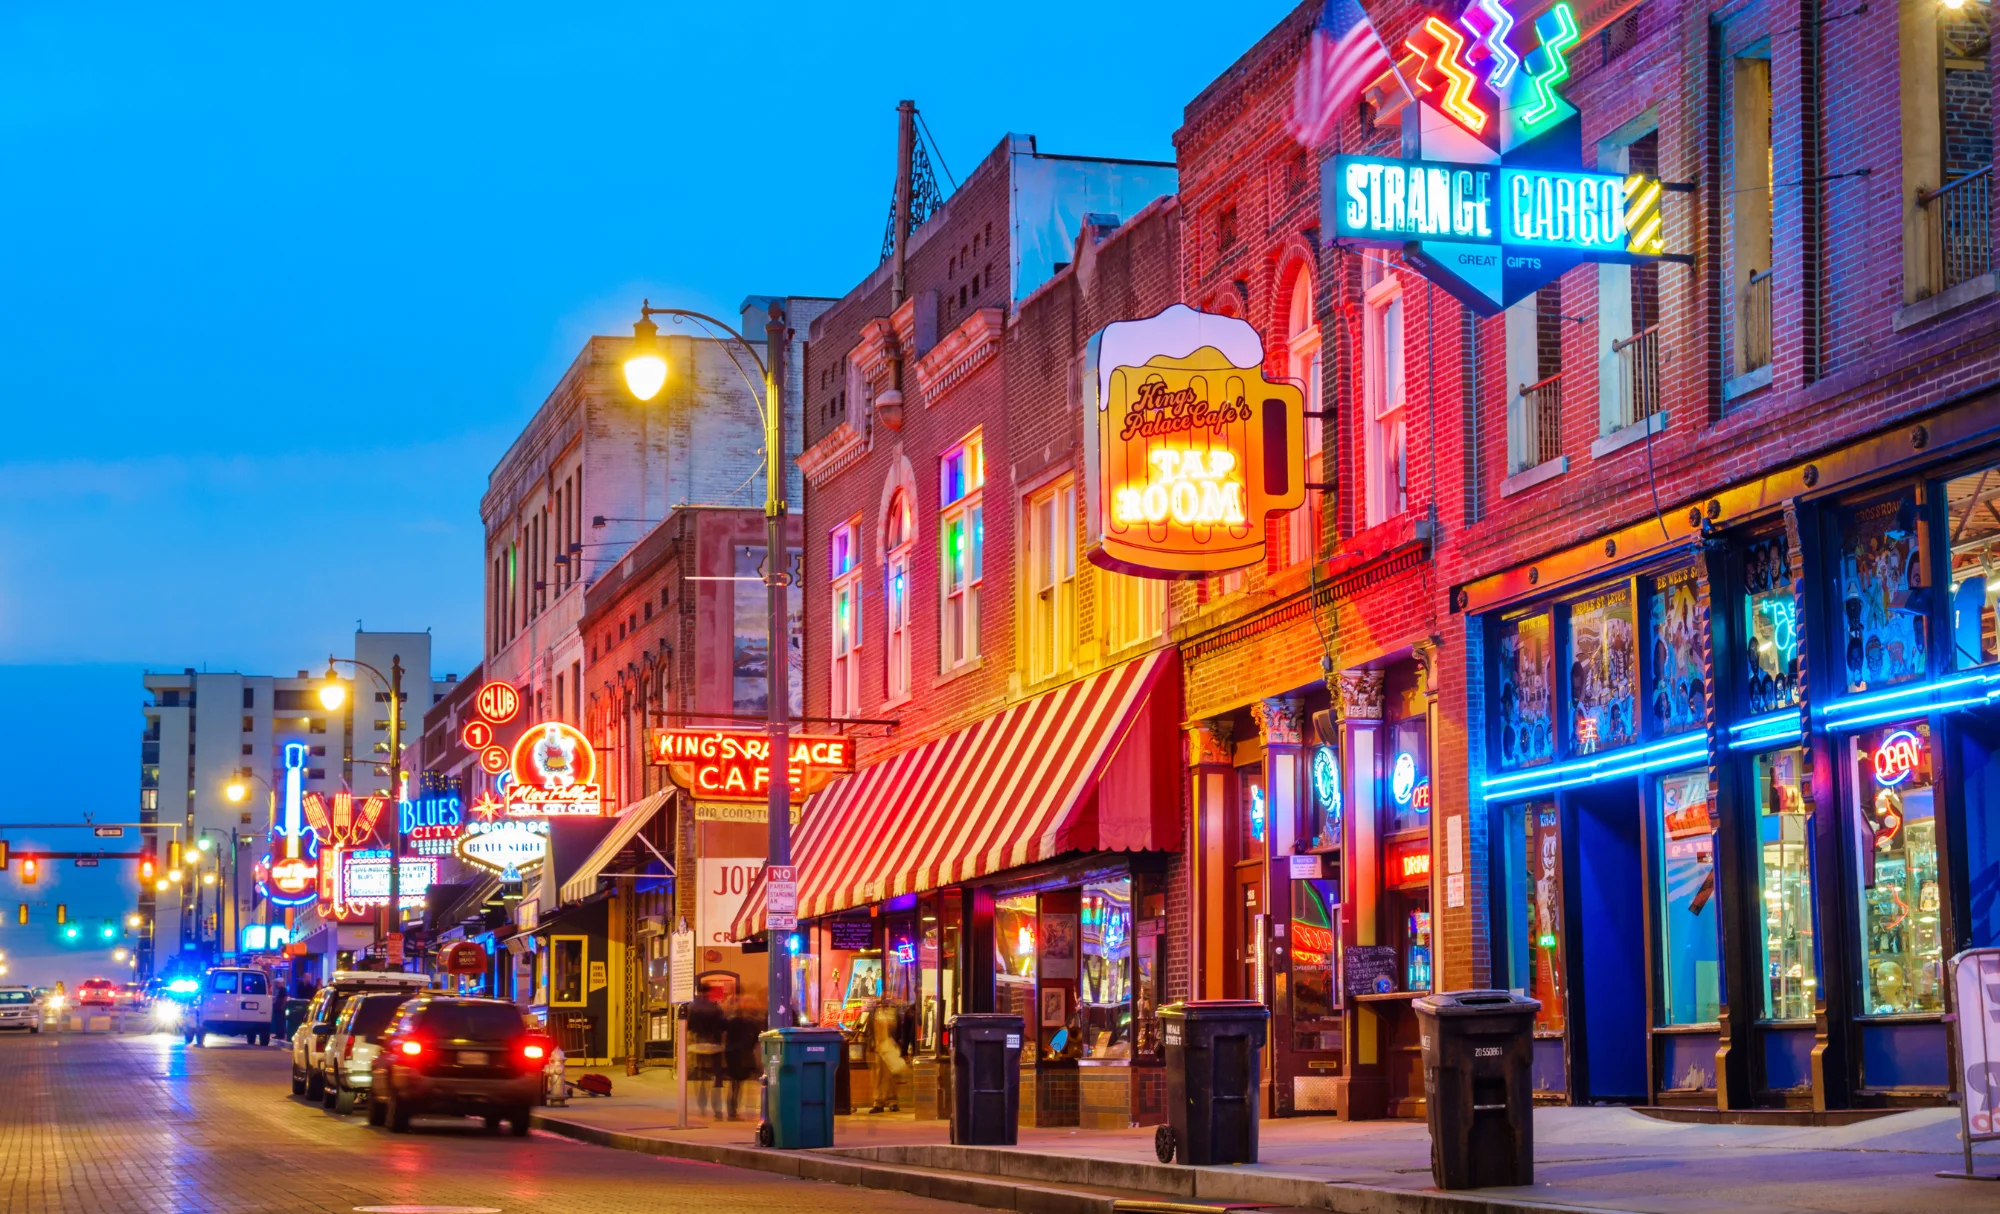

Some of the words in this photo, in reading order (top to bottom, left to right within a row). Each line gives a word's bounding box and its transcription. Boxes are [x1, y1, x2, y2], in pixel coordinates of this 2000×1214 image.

[1346, 163, 1492, 238] STRANGE
[1509, 173, 1618, 244] CARGO
[1458, 254, 1498, 266] GREAT
[1506, 256, 1541, 269] GIFTS
[1120, 406, 1191, 441] Palace
[1189, 396, 1252, 435] Cafe's
[1150, 449, 1236, 483] TAP
[1118, 481, 1246, 526] ROOM
[481, 686, 515, 719] CLUB
[472, 727, 481, 744] 1
[659, 733, 736, 760] KING'S
[746, 739, 844, 765] PAACE
[1874, 741, 1919, 777] OPEN
[488, 751, 502, 768] 5
[699, 766, 802, 792] CAFE
[1412, 785, 1429, 808] OPE
[402, 797, 460, 834] BLUES
[697, 806, 718, 819] AIR
[722, 807, 797, 820] CONDITID
[411, 826, 459, 839] CITY
[410, 839, 457, 849] GENERA
[418, 846, 452, 856] STORE
[508, 842, 542, 852] STREE
[773, 869, 791, 880] NO
[1165, 1035, 1182, 1046] STREET
